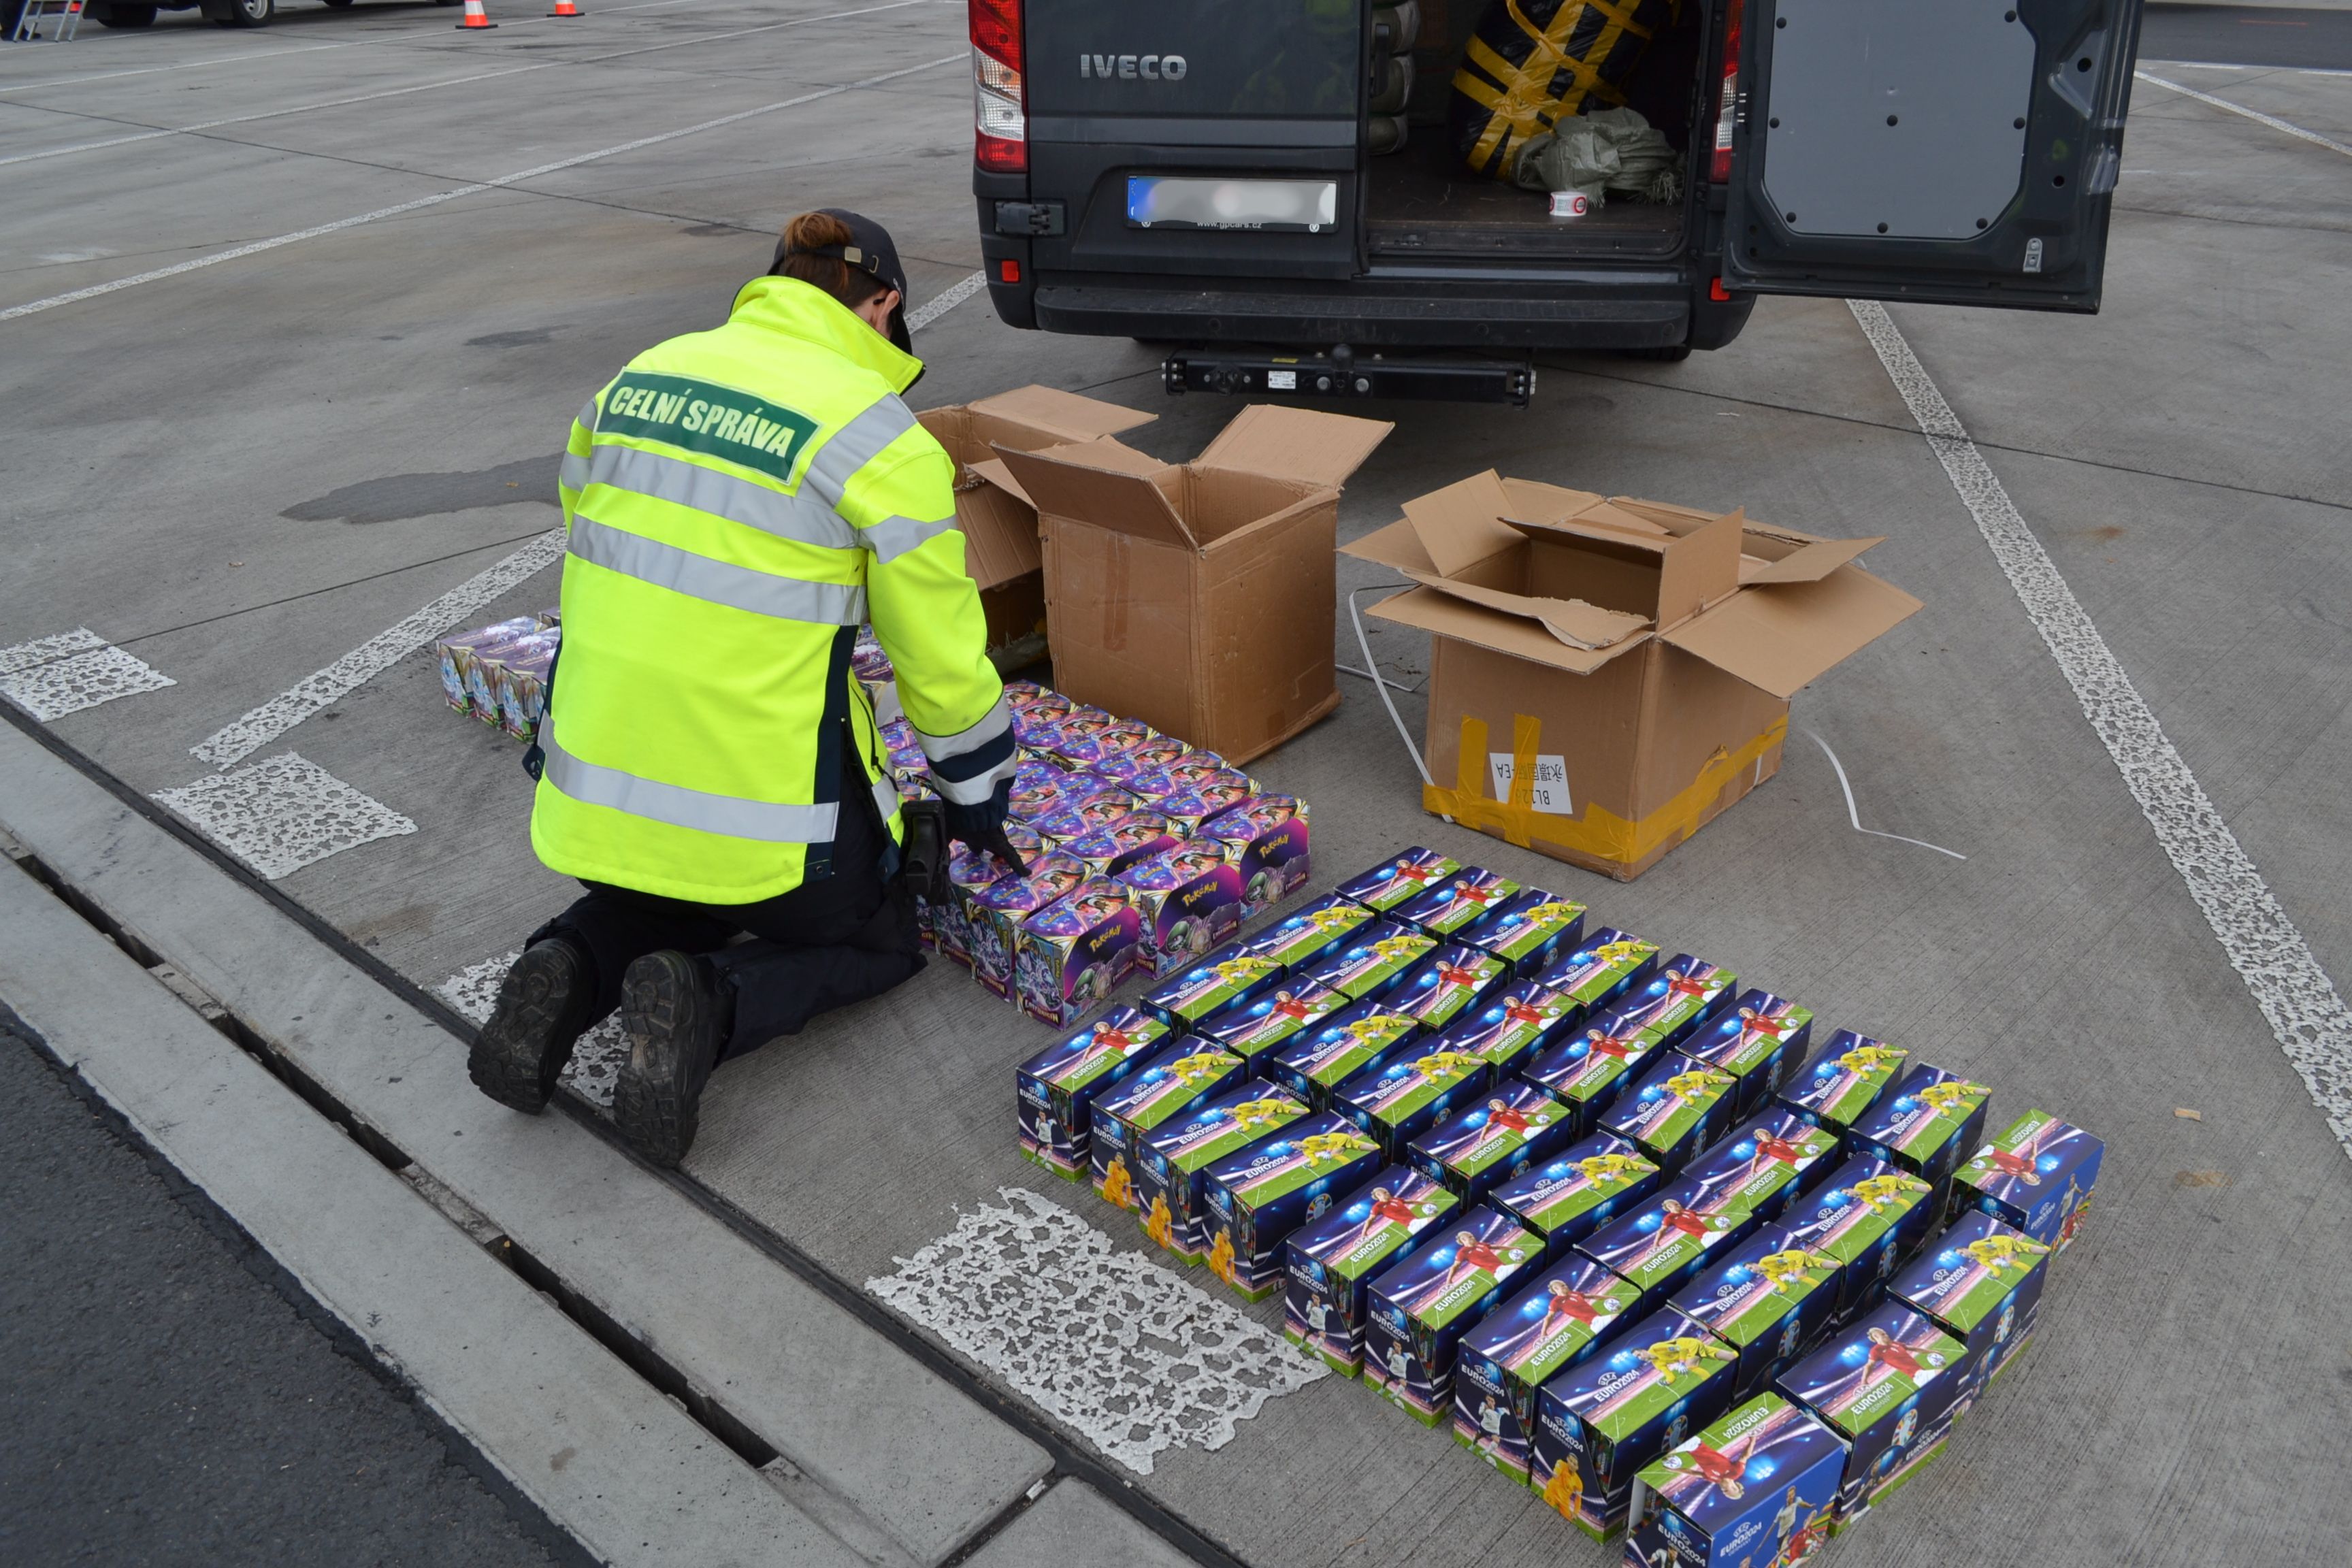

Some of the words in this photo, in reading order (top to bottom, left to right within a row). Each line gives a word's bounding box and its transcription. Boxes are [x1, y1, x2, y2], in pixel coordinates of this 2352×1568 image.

[1080, 54, 1188, 81] IVECO
[609, 386, 693, 425] CELNÍ
[681, 399, 796, 459] SPRÁVA
[1250, 1023, 1286, 1045] EURO2024
[1494, 1029, 1524, 1054] EURO2024
[1311, 1039, 1345, 1063] EURO2024
[1071, 1054, 1107, 1080] EURO2024
[1579, 1063, 1610, 1088] EURO2024
[1019, 1088, 1051, 1111] EURO2024
[1129, 1079, 1166, 1106] EURO2024
[1375, 1075, 1411, 1100] EURO2024
[1637, 1098, 1667, 1124] EURO2024
[1093, 1126, 1126, 1151] EURO2024
[1178, 1121, 1222, 1145] EURO2024
[1469, 1137, 1506, 1163] EURO2024
[1140, 1159, 1169, 1188] EURO2024
[1244, 1154, 1290, 1179] EURO2024
[1531, 1177, 1572, 1203] EURO2024
[1744, 1169, 1779, 1196] EURO2024
[1204, 1192, 1233, 1224] EURO2024
[1818, 1204, 1852, 1232] EURO2024
[1350, 1232, 1390, 1263] EURO2024
[1642, 1243, 1683, 1273] EURO2024
[1289, 1264, 1328, 1294] EURO2024
[1933, 1266, 1969, 1297] EURO2024
[1434, 1279, 1476, 1312] EURO2024
[1715, 1281, 1755, 1313] EURO2024
[1370, 1310, 1410, 1343] EURO2024
[1530, 1331, 1572, 1367] EURO2024
[1460, 1364, 1505, 1397] EURO2024
[1593, 1369, 1641, 1403] EURO2024
[1850, 1382, 1894, 1416] EURO2024
[1541, 1414, 1584, 1453] EURO2024
[1722, 1406, 1770, 1439] EURO2024
[1658, 1523, 1706, 1568] EURO2024
[1720, 1522, 1763, 1558] EURO2024
